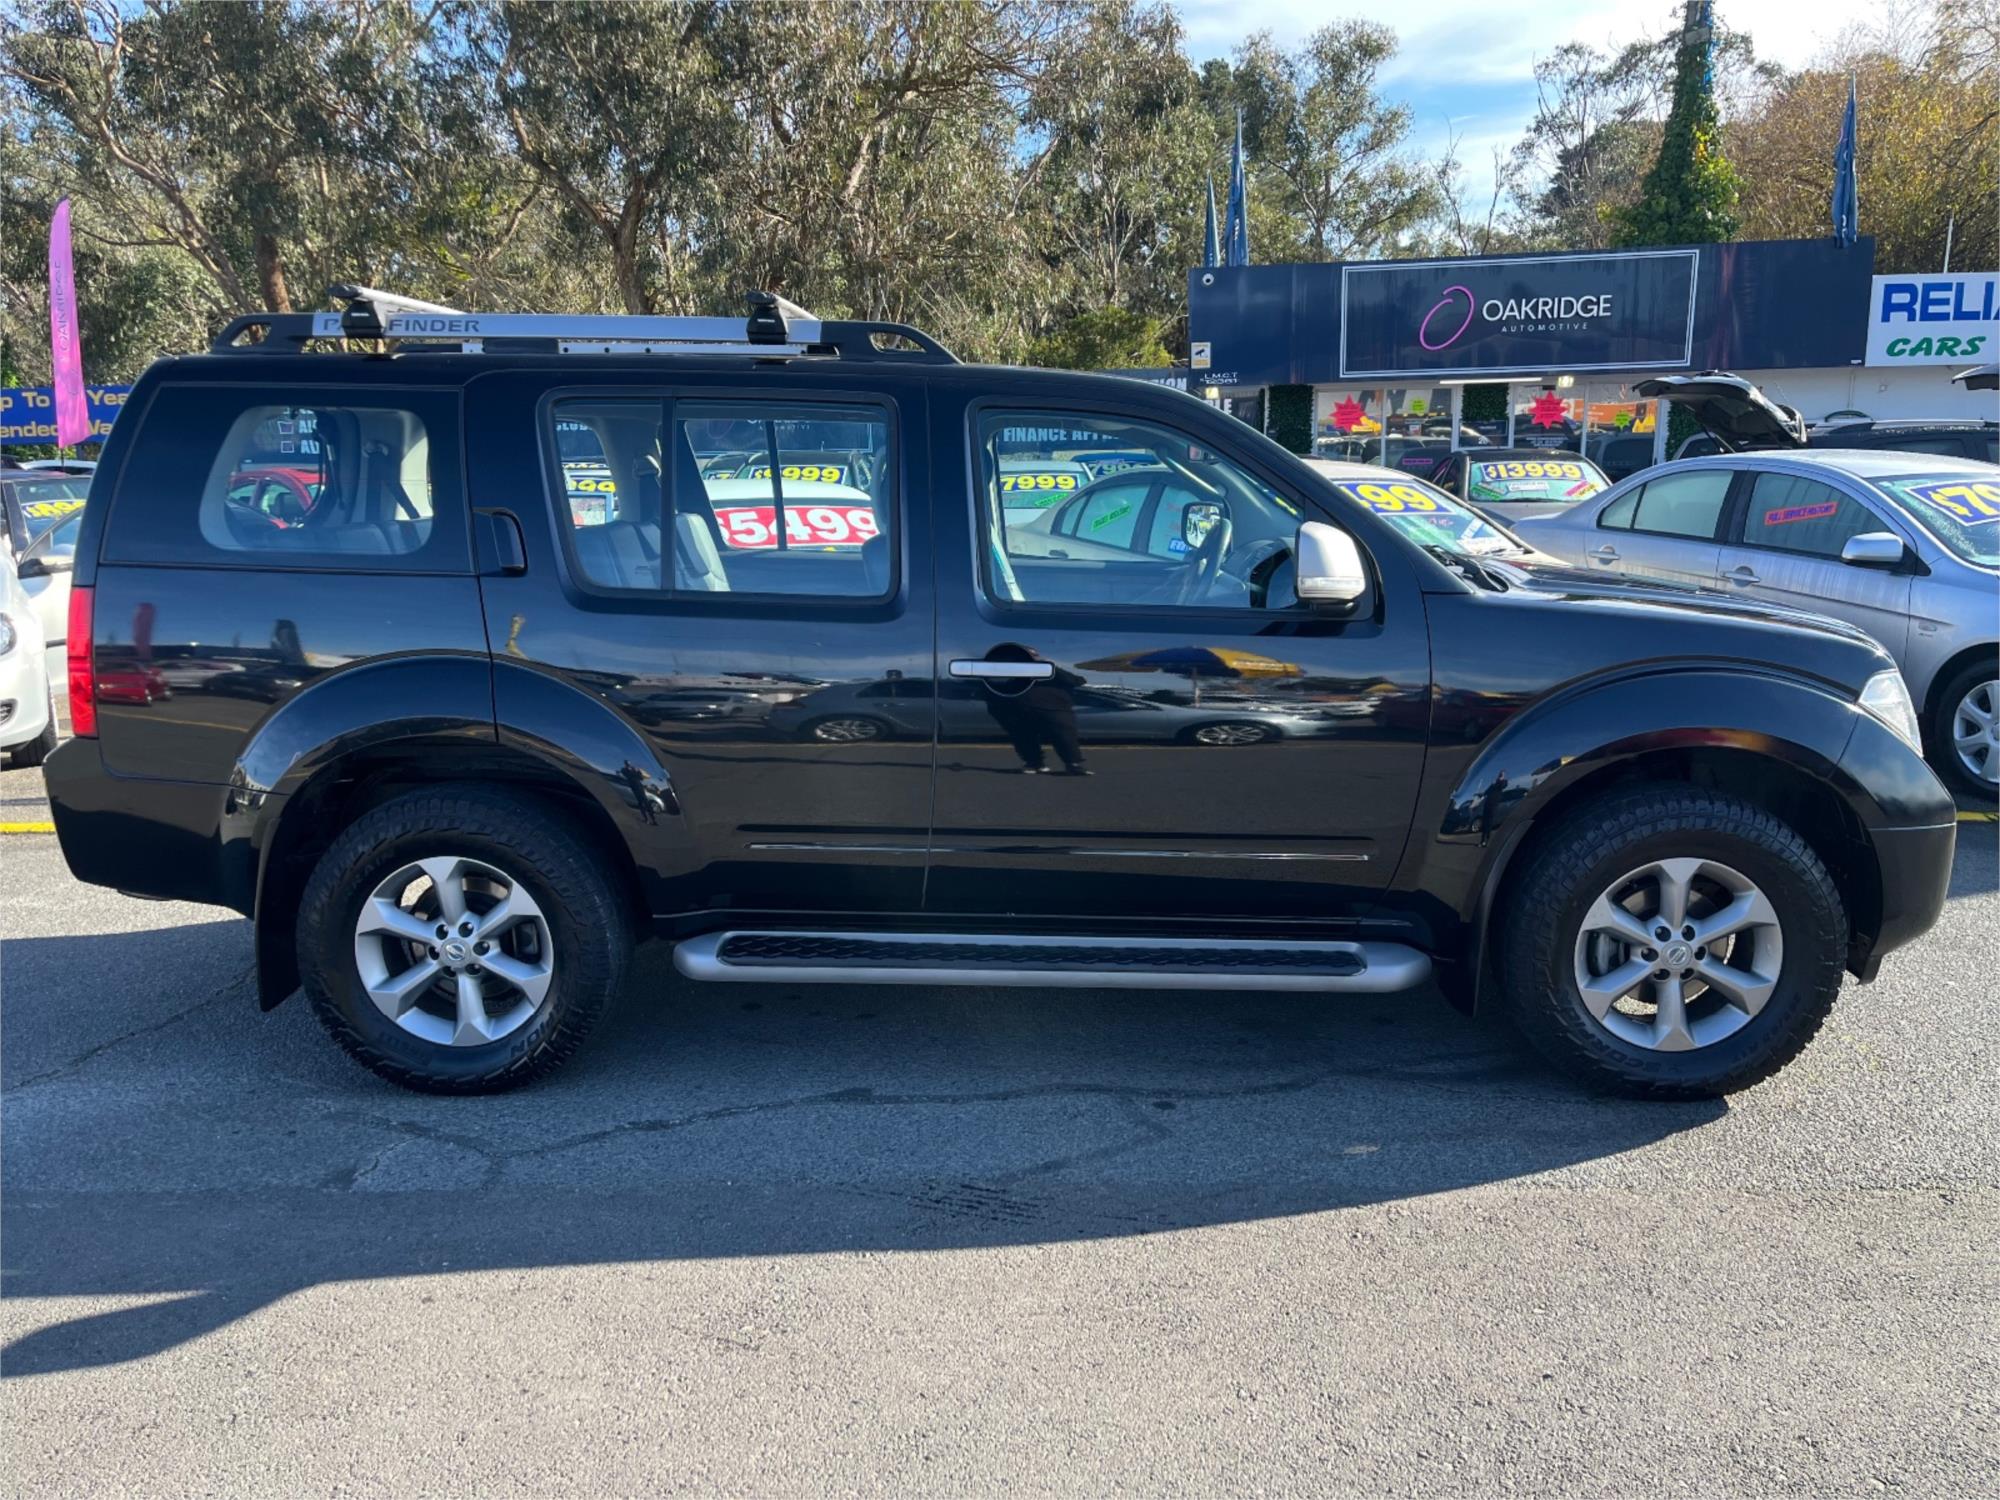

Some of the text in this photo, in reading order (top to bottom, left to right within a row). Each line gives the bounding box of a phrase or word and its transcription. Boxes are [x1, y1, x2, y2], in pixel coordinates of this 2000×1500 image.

[1482, 295, 1613, 321] OAKRIDGE
[1881, 281, 1999, 323] RELI
[323, 318, 480, 332] PFINDER
[1501, 322, 1588, 333] AUTOMOTIVE
[1886, 336, 1987, 357] CARS
[22, 391, 50, 408] To
[1003, 427, 1067, 442] FINANCE
[1486, 463, 1582, 479] $13999
[1341, 484, 1438, 512] 99
